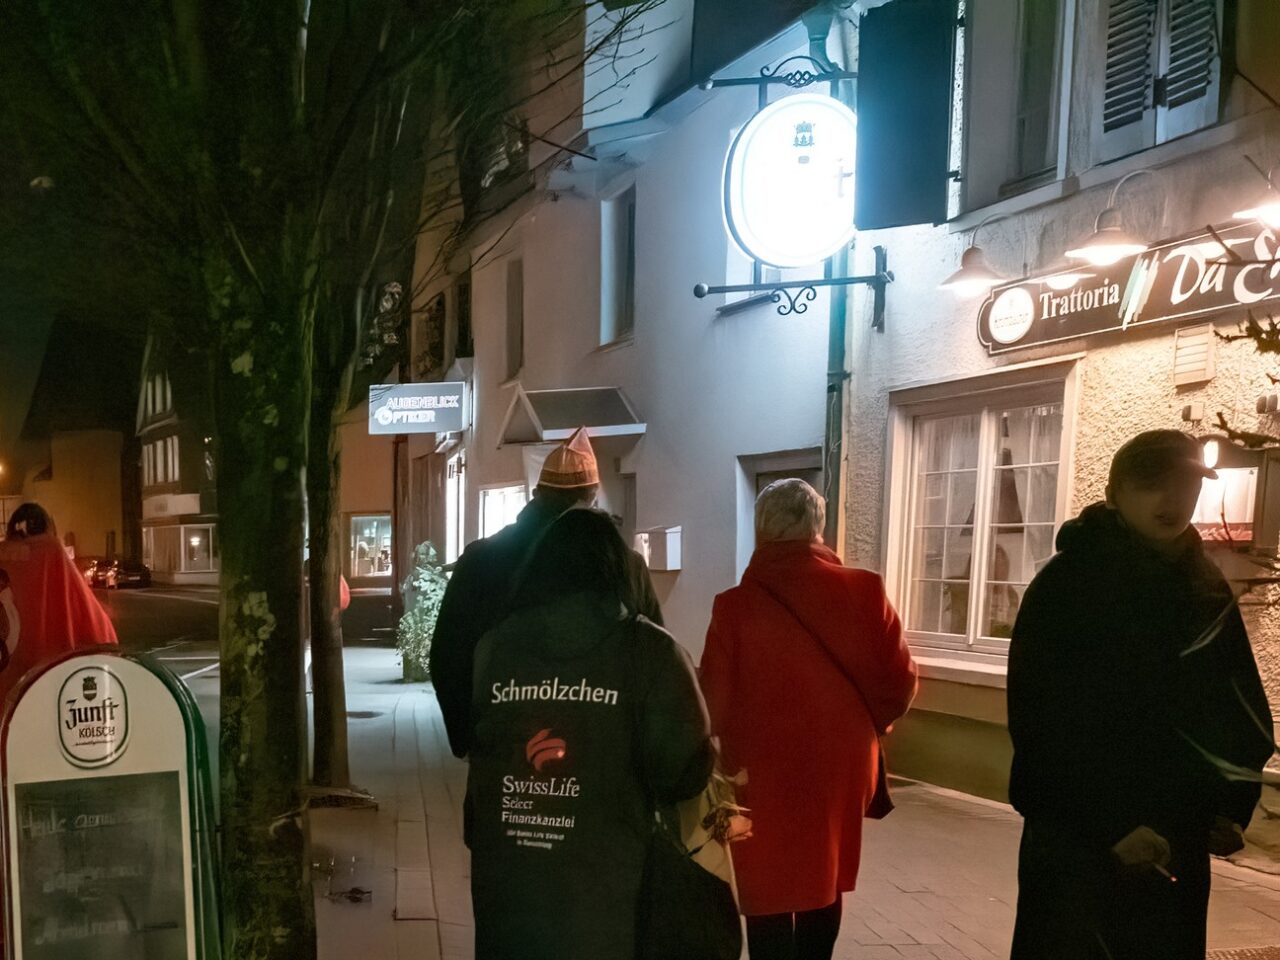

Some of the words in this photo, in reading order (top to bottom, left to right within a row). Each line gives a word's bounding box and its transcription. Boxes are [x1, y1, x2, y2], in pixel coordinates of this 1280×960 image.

[1039, 278, 1120, 321] Trattoria
[1163, 243, 1230, 305] Da
[385, 395, 460, 410] AUGENBLICK
[491, 676, 619, 705] Schmölzchen
[502, 774, 581, 798] SwissLife
